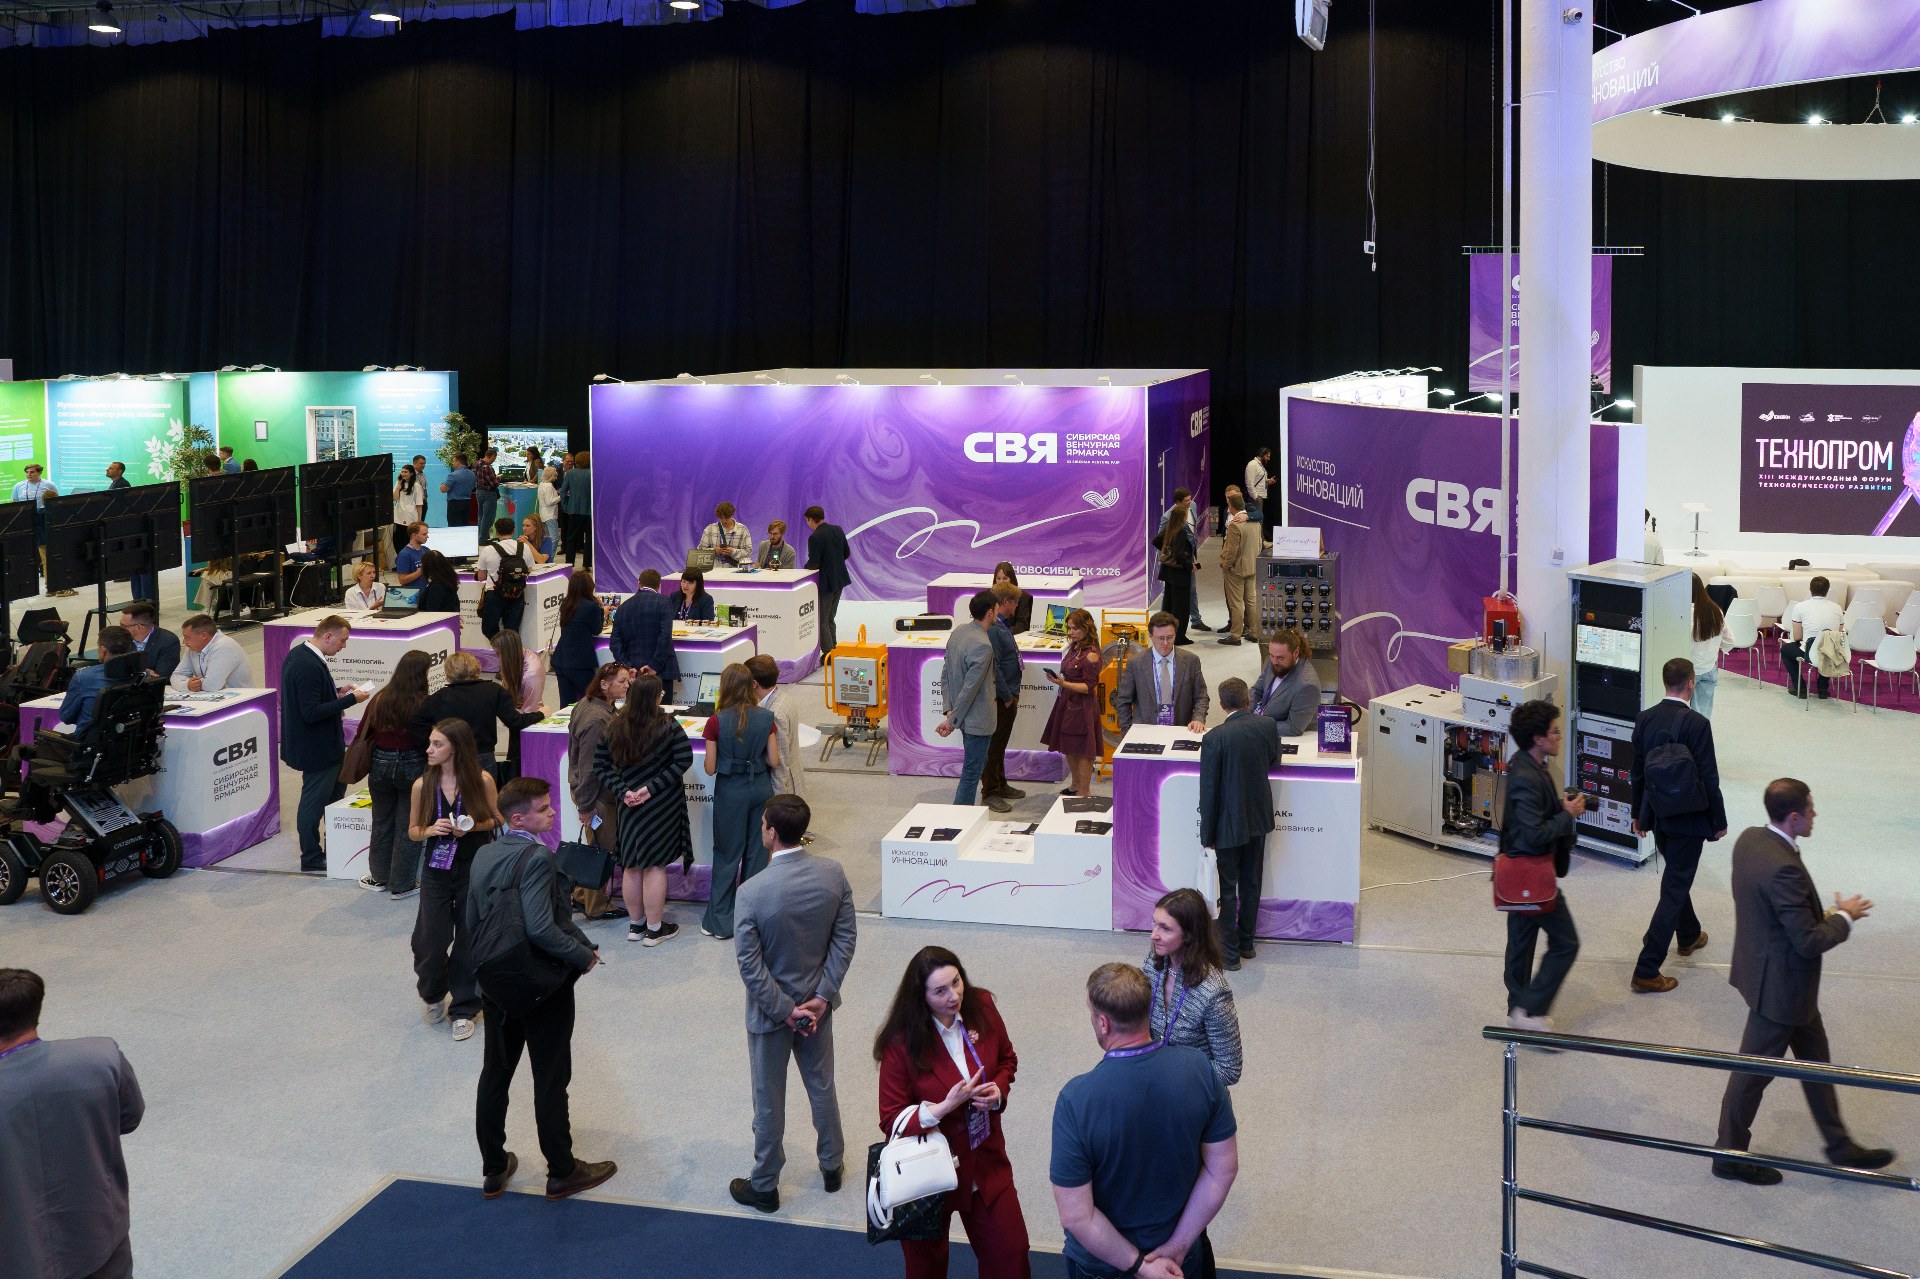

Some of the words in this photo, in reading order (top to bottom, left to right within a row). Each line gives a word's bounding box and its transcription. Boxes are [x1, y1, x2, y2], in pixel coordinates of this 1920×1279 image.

[964, 432, 1058, 463] СВЯ
[1066, 441, 1120, 449] ВЕНЧУРНАЯ
[1756, 439, 1893, 471] ТЕХНОПРОМ
[1297, 455, 1336, 476] ИСКУССТВО
[1779, 474, 1858, 482] МЕЖДУНАРОДНЫЙ
[1297, 473, 1363, 509] ИННОВАЦИЙ
[1406, 478, 1502, 536] СВЯ
[1014, 566, 1094, 576] НОВОСИБИСК
[1096, 567, 1121, 577] 2026
[799, 600, 815, 617] СВЯ
[429, 649, 448, 668] ВЯ
[213, 736, 257, 766] СВЯ
[214, 763, 258, 786] СИБИРСКАЯ
[214, 771, 258, 794] ВЕНЧУРНАЯ
[214, 783, 250, 801] ЯРМАРКА
[684, 783, 706, 791] ЕНТР
[891, 856, 948, 867] ИННОВАЦИЙ
